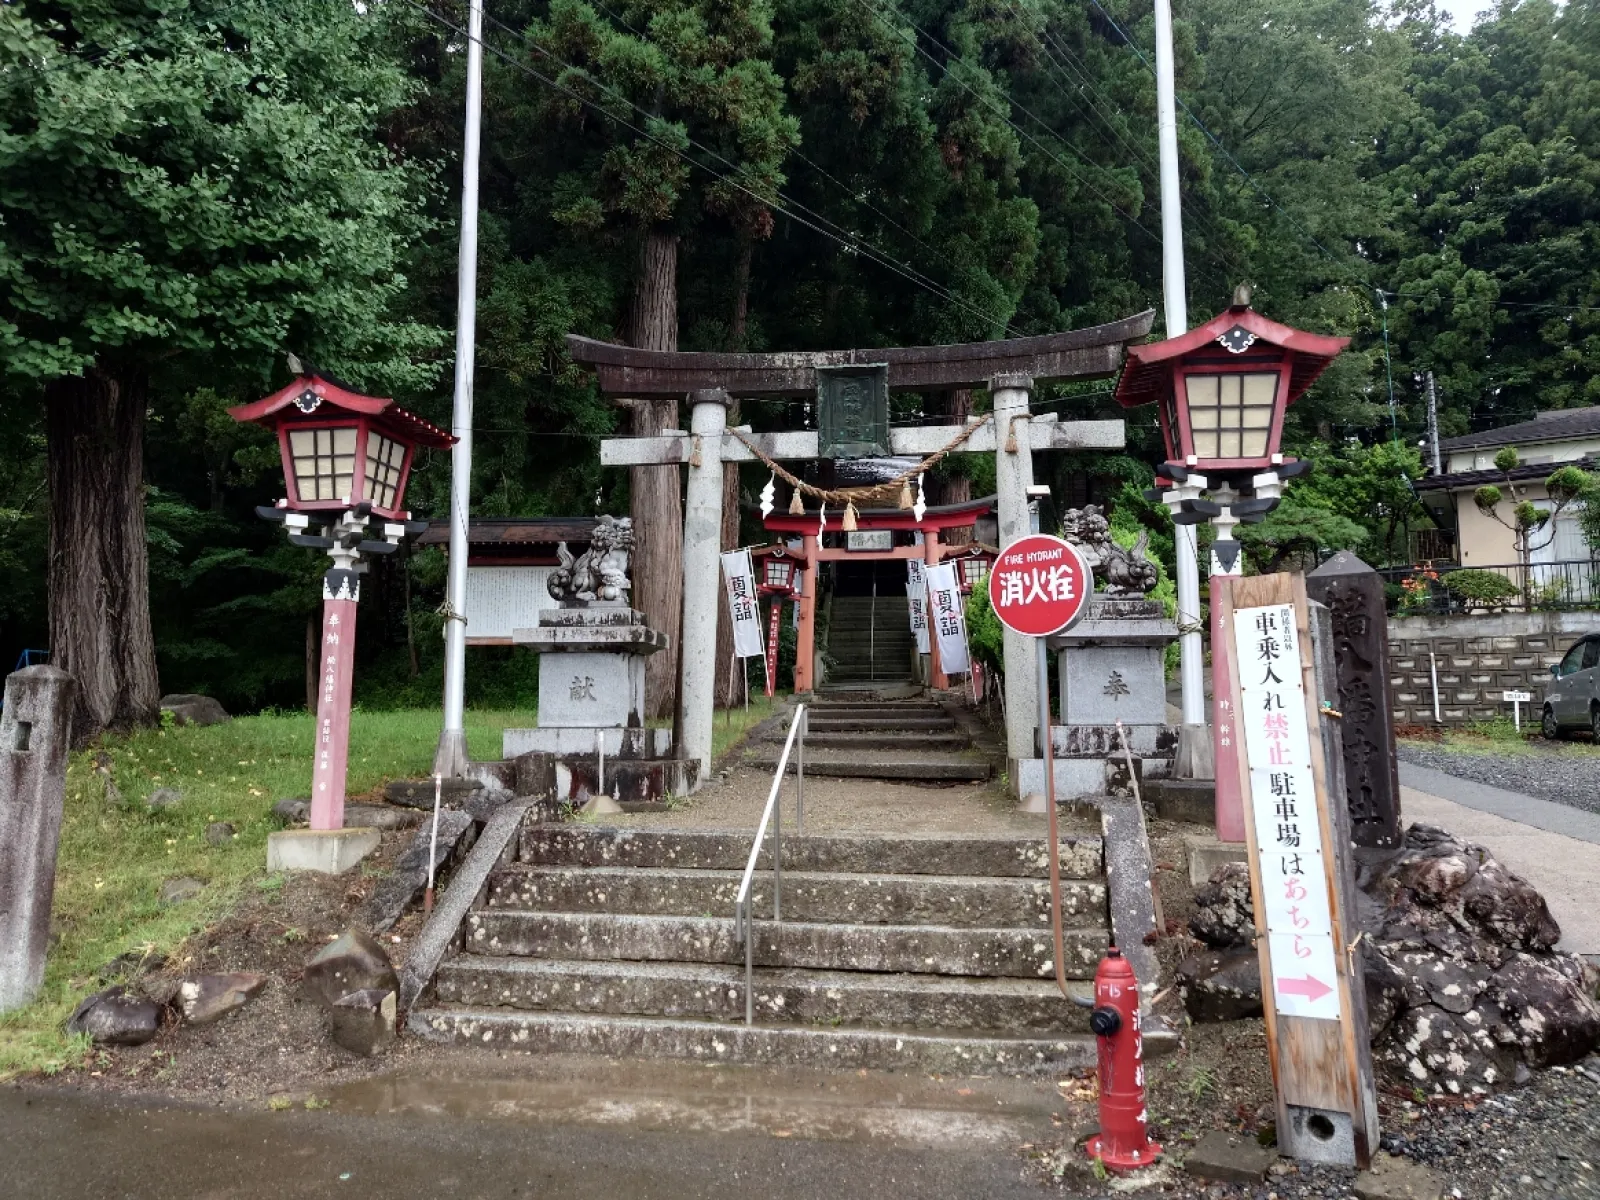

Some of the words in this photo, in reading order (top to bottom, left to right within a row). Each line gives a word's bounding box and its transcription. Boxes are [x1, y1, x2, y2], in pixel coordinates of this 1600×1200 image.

[1004, 553, 1024, 566] FIRE
[1027, 548, 1063, 563] HYDRANT
[999, 564, 1076, 607] 消火栓
[569, 675, 598, 702] 献
[1103, 670, 1131, 702] 奉
